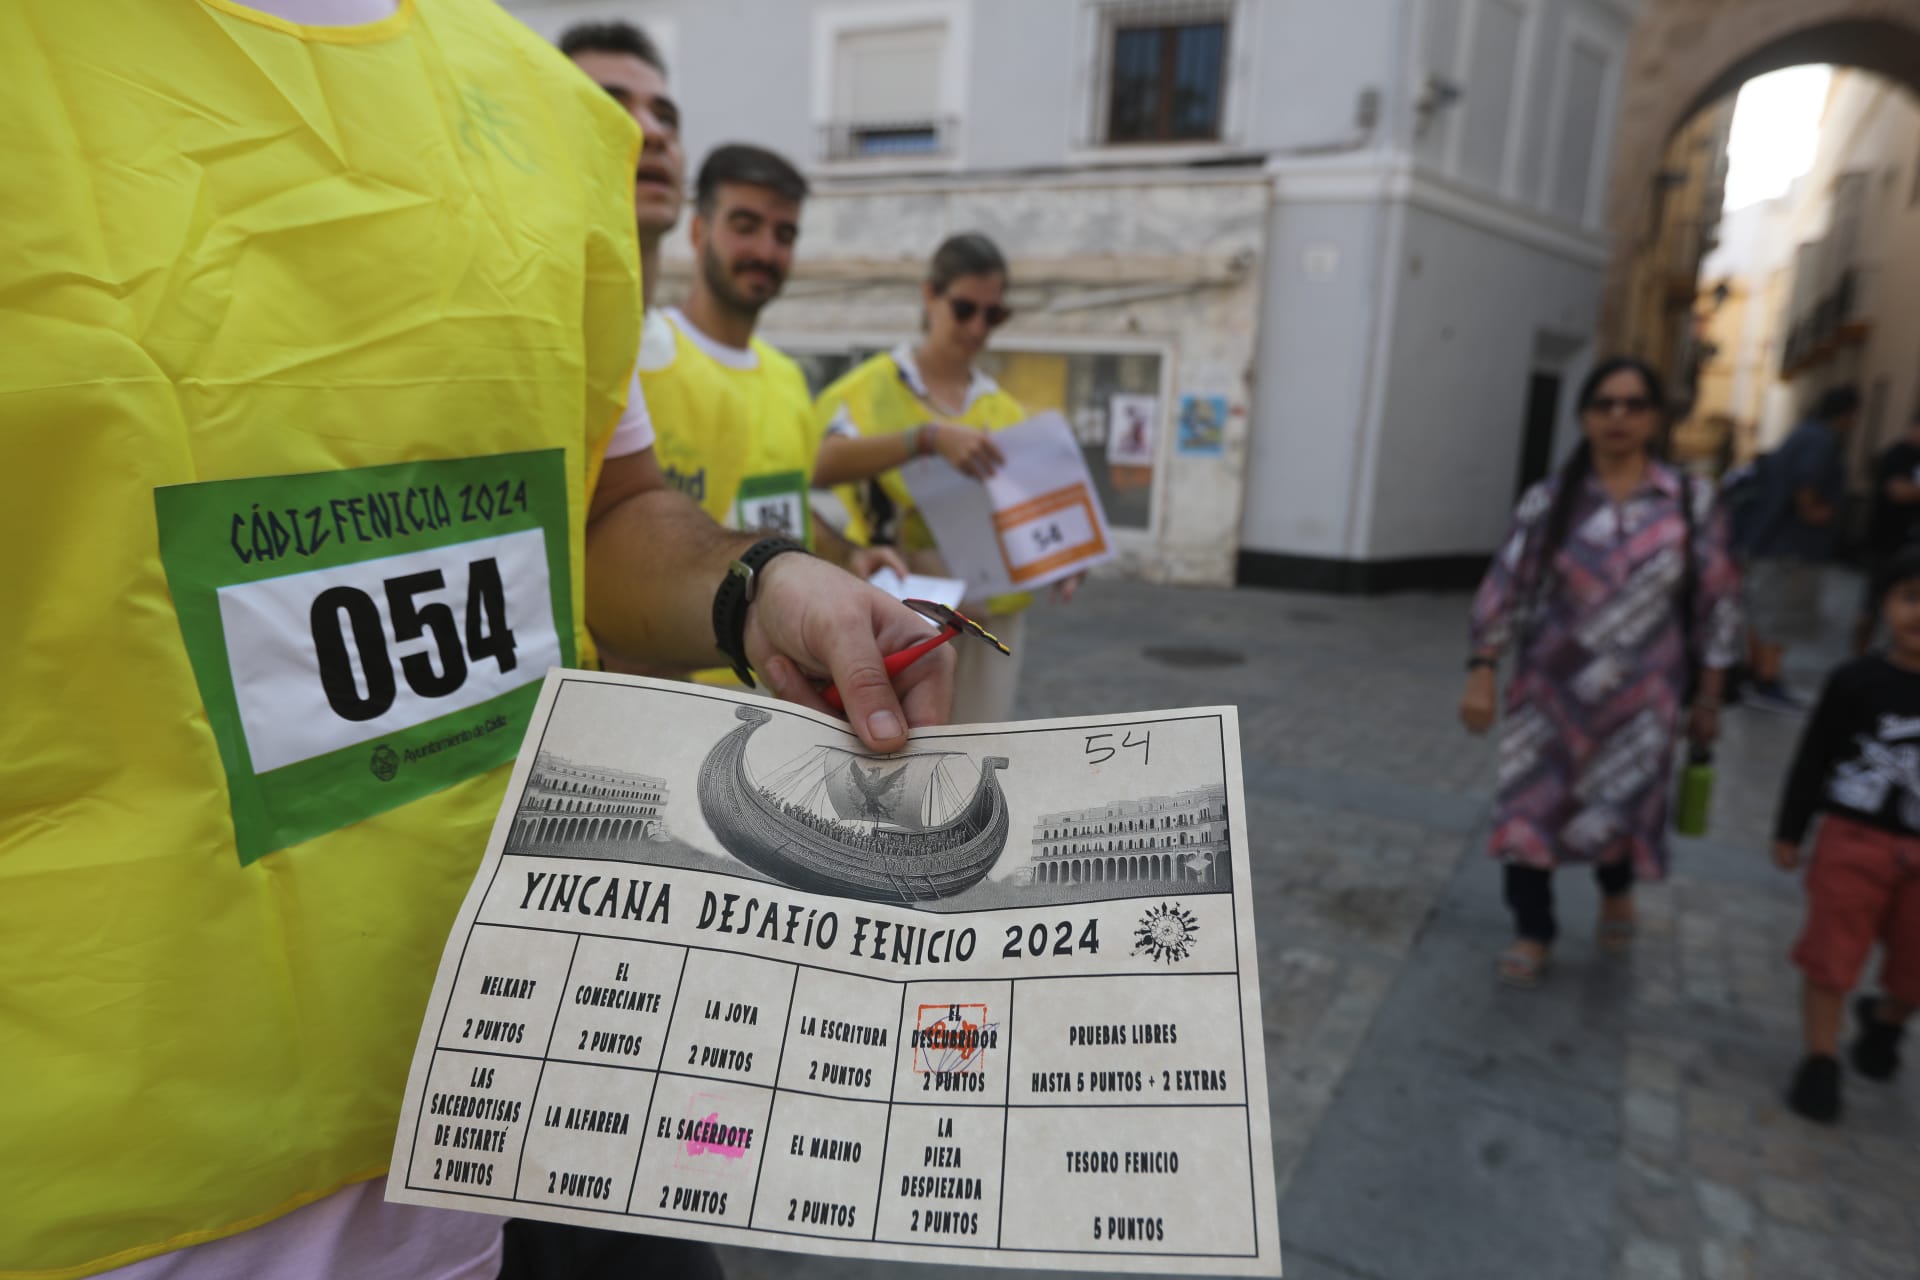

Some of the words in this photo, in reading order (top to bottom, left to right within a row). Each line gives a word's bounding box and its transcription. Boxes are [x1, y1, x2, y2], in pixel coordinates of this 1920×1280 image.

[459, 480, 527, 522] 2024
[310, 557, 518, 722] 054
[1085, 730, 1150, 765] 54
[519, 871, 671, 925] YINCANA
[849, 916, 977, 966] FENICIO
[1002, 918, 1099, 960] 2024
[615, 962, 630, 982] EL
[479, 975, 537, 1000] MELKART
[575, 985, 662, 1014] COMERCIANTE
[704, 999, 721, 1021] LA
[724, 1002, 758, 1026] JOYA
[949, 1005, 961, 1021] EL
[462, 1018, 474, 1039] 2
[474, 1019, 526, 1044] PUNTOS
[577, 1029, 589, 1050] 2
[590, 1031, 643, 1057] PUNTOS
[800, 1015, 816, 1037] LA
[820, 1019, 888, 1047] ESCRITURA
[911, 1030, 997, 1048] DESCUBRIDOR
[1069, 1024, 1127, 1046] PRUEBAS
[1132, 1023, 1177, 1045] LIBRES
[687, 1044, 698, 1065] 2
[700, 1046, 754, 1073] PUNTOS
[470, 1066, 495, 1090] LAS
[808, 1060, 818, 1081] 2
[821, 1062, 872, 1088] PUNTOS
[923, 1072, 931, 1091] 2
[936, 1072, 985, 1092] PUNTOS
[1031, 1072, 1072, 1093] HASTA
[1077, 1071, 1085, 1093] 5
[1090, 1070, 1142, 1093] PUNTOS
[1148, 1075, 1155, 1087] +
[1162, 1070, 1171, 1092] 2
[1175, 1069, 1227, 1091] EXTRAS
[430, 1092, 522, 1123] SACERDOTISAS
[544, 1105, 562, 1128] LA
[564, 1107, 630, 1136] ALFARERA
[433, 1123, 451, 1147] DE
[452, 1125, 509, 1153] ASTARTÉ
[657, 1116, 671, 1138] EL
[676, 1119, 754, 1149] SACERDOTE
[937, 1117, 953, 1138] LA
[790, 1134, 804, 1156] EL
[809, 1137, 862, 1164] MARINO
[923, 1146, 961, 1169] PIEZA
[1066, 1151, 1119, 1174] TESORO
[1125, 1151, 1179, 1174] FENICIO
[433, 1157, 443, 1180] 2
[445, 1159, 494, 1187] PUNTOS
[547, 1171, 557, 1194] 2
[559, 1172, 613, 1201] PUNTOS
[659, 1185, 670, 1209] 2
[672, 1186, 728, 1216] PUNTOS
[900, 1175, 982, 1201] DESPIEZADA
[787, 1198, 798, 1222] 2
[801, 1199, 856, 1228] PUNTOS
[910, 1209, 920, 1232] 2
[924, 1210, 978, 1235] PUNTOS
[1093, 1216, 1102, 1240] 5
[1108, 1216, 1164, 1241] PUNTOS
